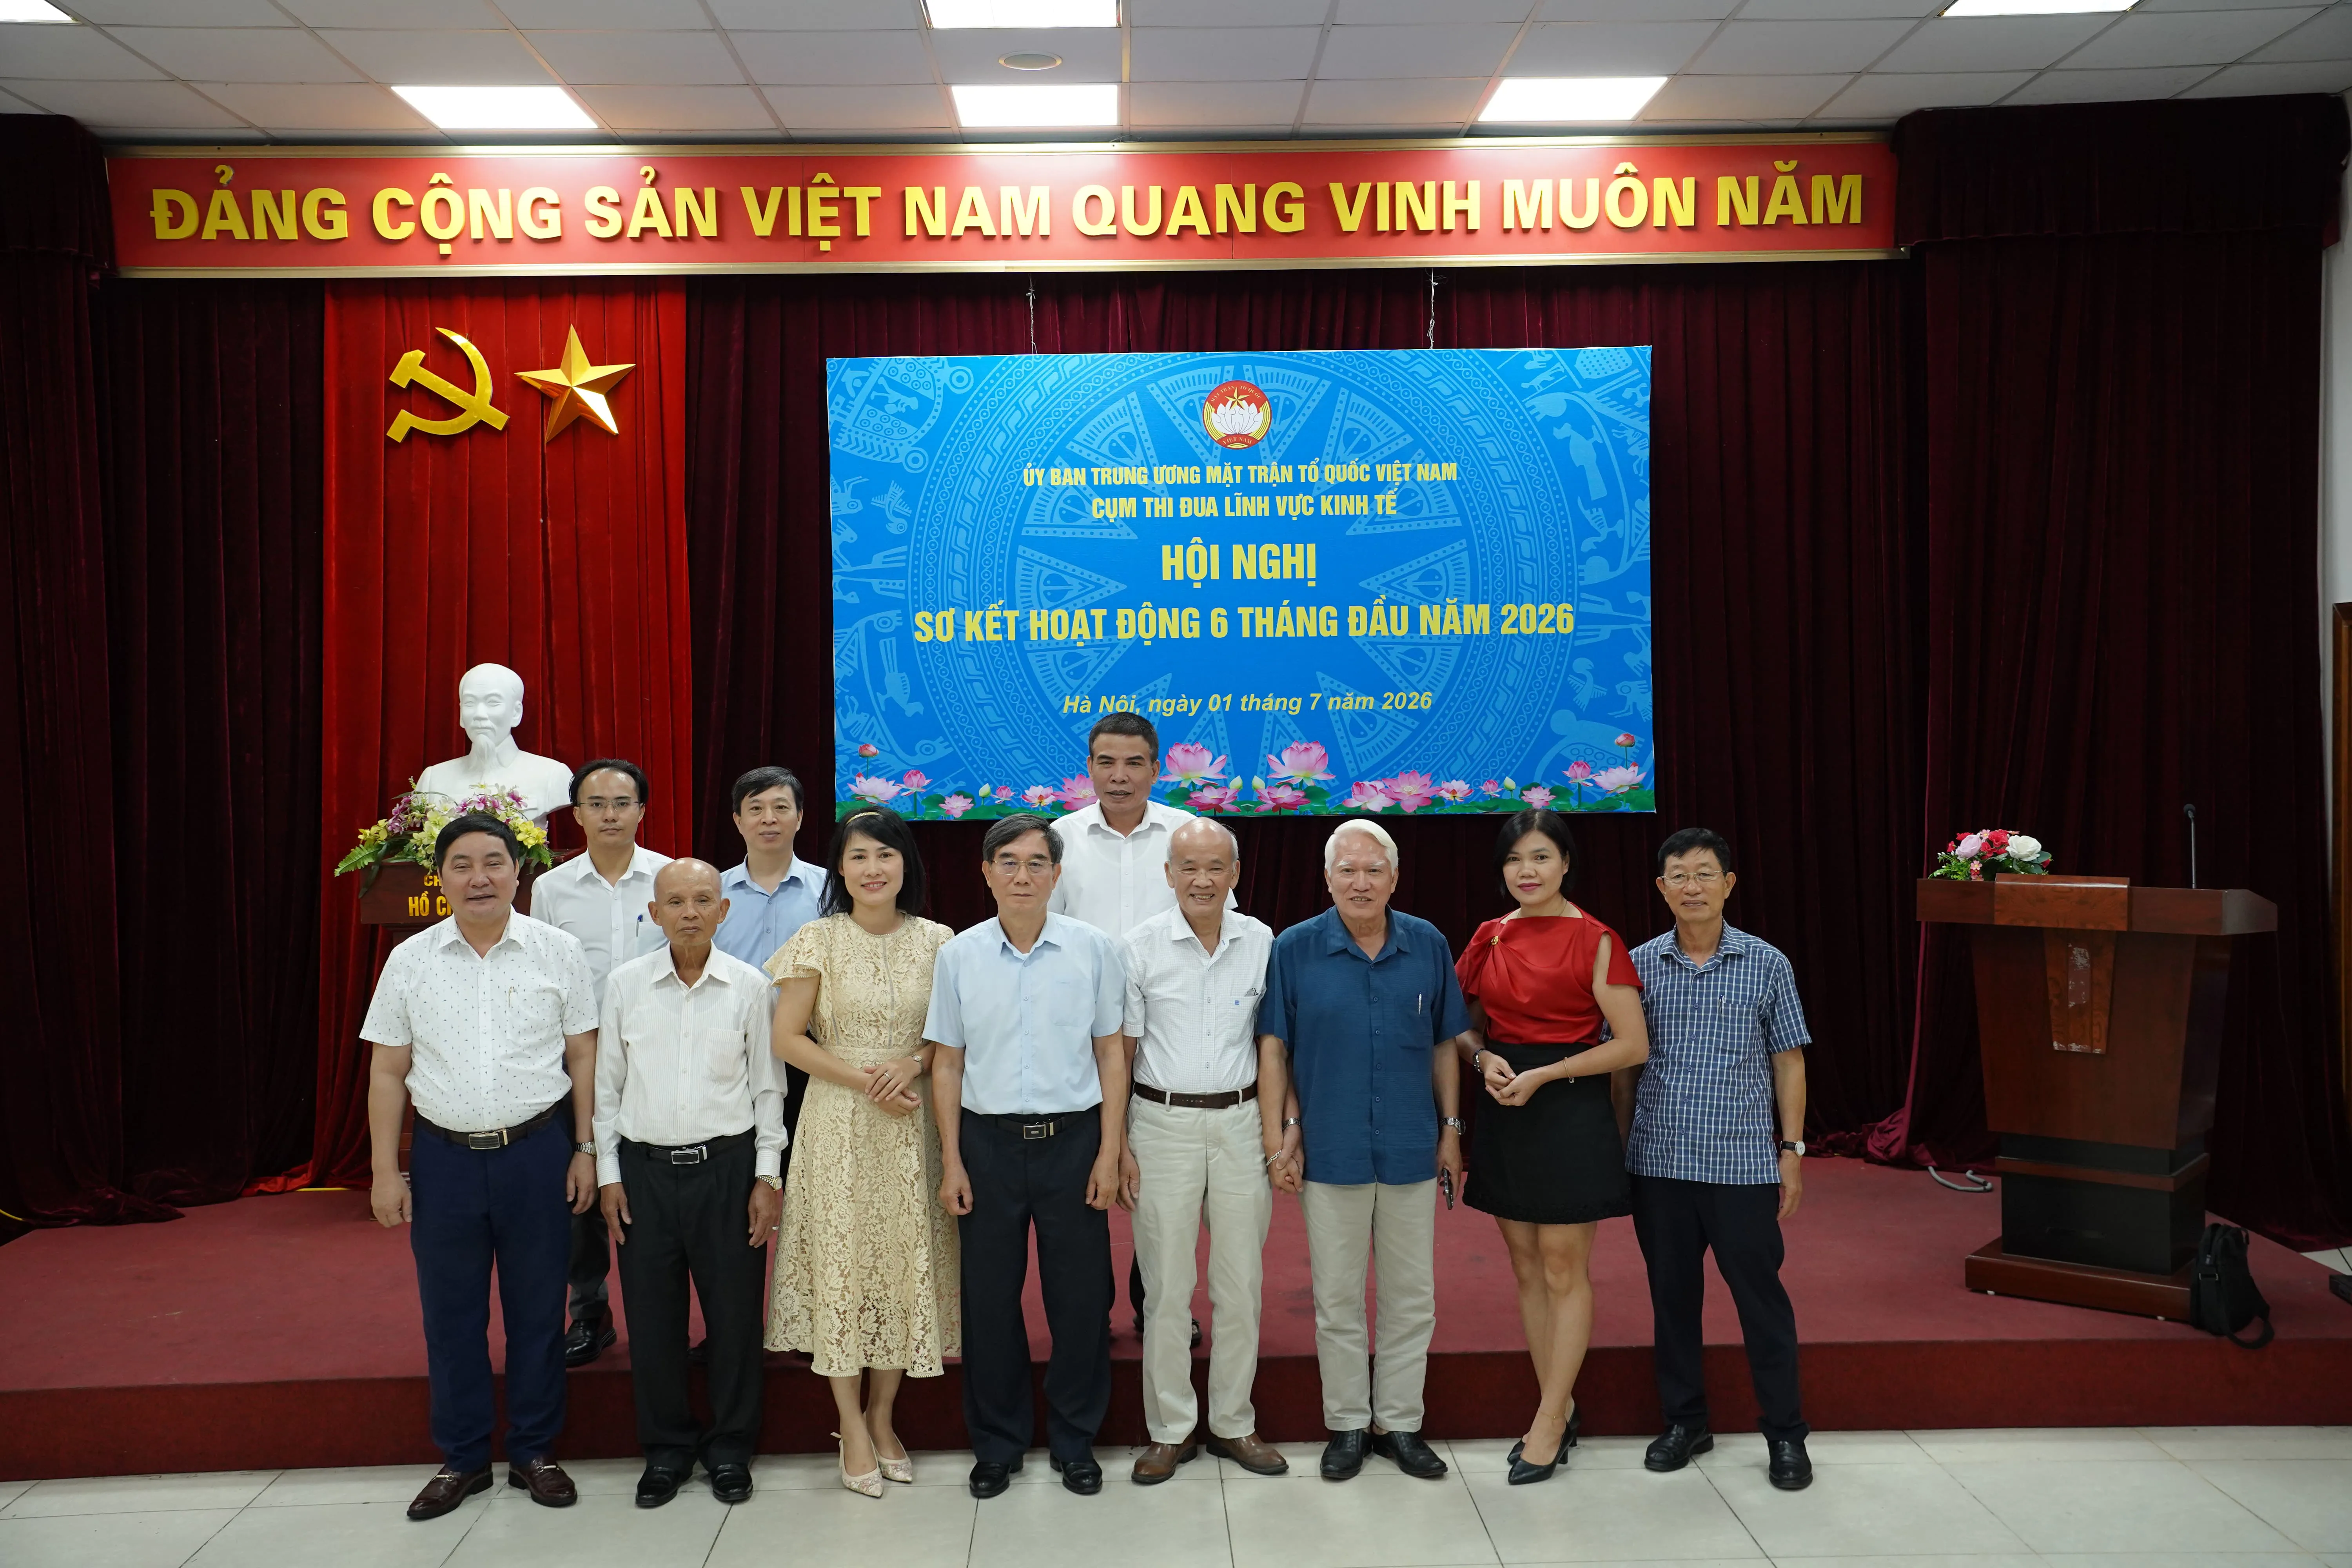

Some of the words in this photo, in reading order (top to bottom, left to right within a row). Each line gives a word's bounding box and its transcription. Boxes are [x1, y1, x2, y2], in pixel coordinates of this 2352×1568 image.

[150, 165, 348, 240] ĐẢNG
[373, 172, 561, 254] CỘNG
[584, 165, 717, 238] SẢN
[740, 172, 881, 251] VIỆT
[905, 186, 1051, 236] NAM
[1072, 181, 1305, 236] QUANG
[1329, 180, 1480, 232] VINH
[1503, 162, 1695, 229] MUÔN
[1717, 160, 1862, 226] NĂM
[1024, 463, 1045, 486] ỦY
[1051, 468, 1086, 485] BAN
[1091, 467, 1148, 485] TRUNG
[1153, 465, 1200, 484] ƯƠNG
[1206, 462, 1243, 487] MẶT
[1247, 462, 1293, 487] TRẬN
[1298, 457, 1319, 483] TỔ
[1325, 458, 1370, 484] QUỐC
[1376, 460, 1412, 485] VIỆT
[1417, 463, 1457, 481] NAM
[1092, 498, 1136, 523] CỤM
[1143, 497, 1173, 517] THI
[1180, 497, 1218, 517] ĐUA
[1225, 492, 1269, 516] LĨNH
[1276, 494, 1314, 520] VỰC
[1321, 495, 1368, 515] KINH
[1374, 488, 1398, 515] TẾ
[1162, 537, 1219, 588] HỘI
[1232, 543, 1316, 587] NGHỊ
[915, 608, 955, 642] SƠ
[965, 600, 1020, 641] KẾT
[1030, 609, 1107, 647] HOẠT
[1116, 601, 1200, 646] ĐỘNG
[1210, 607, 1228, 638] 6
[1238, 600, 1338, 638] THÁNG
[1347, 594, 1408, 636] ĐẦU
[1420, 598, 1490, 635] NĂM
[1501, 603, 1574, 634] 2026
[1063, 695, 1092, 713] Hà
[1148, 694, 1202, 717] ngày
[1209, 694, 1232, 711] 01
[1241, 693, 1302, 715] tháng
[1310, 693, 1322, 710] 7
[1328, 692, 1374, 710] năm
[1382, 691, 1432, 710] 2026
[424, 875, 442, 886] CH
[408, 891, 430, 916] HỒ
